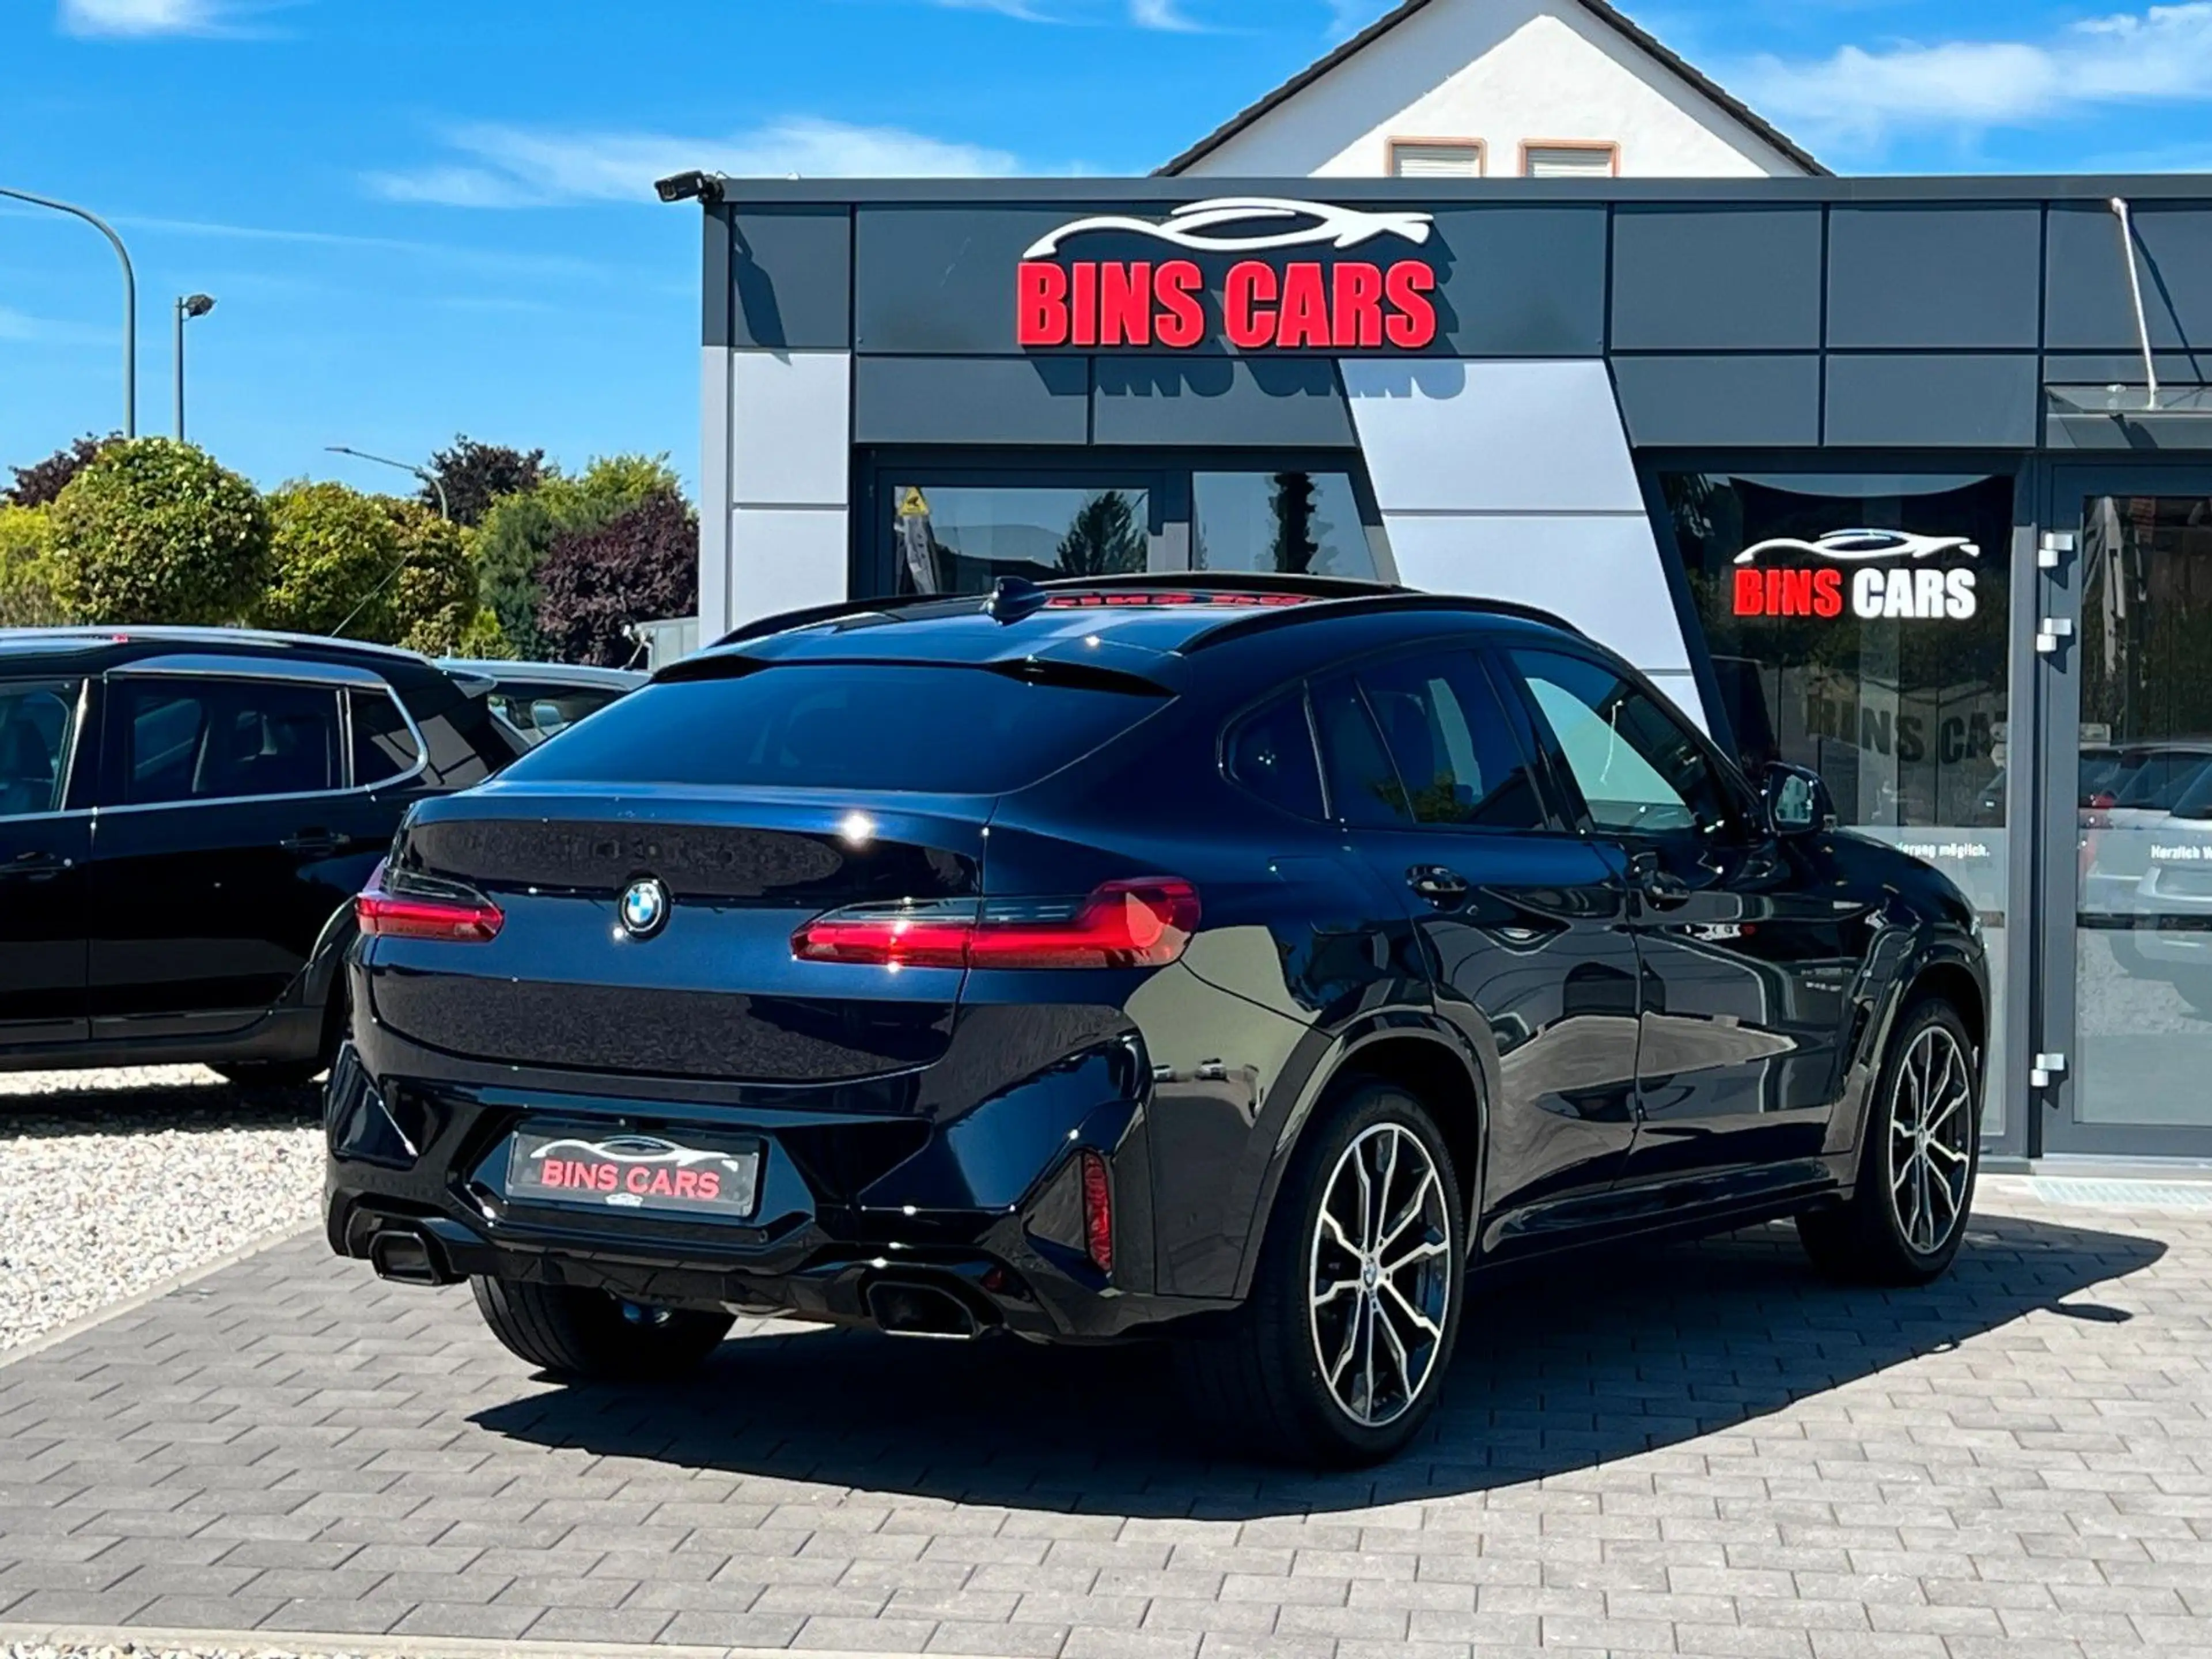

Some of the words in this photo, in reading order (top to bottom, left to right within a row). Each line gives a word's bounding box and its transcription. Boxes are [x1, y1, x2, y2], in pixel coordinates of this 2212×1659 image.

[1017, 260, 1205, 347] BINS
[1224, 260, 1437, 348] CARS
[1733, 567, 1843, 618] BINS
[1852, 567, 1976, 619] CARS
[2150, 844, 2200, 859] Herzlich
[541, 1159, 619, 1191] BINS
[626, 1166, 720, 1199] CARS
